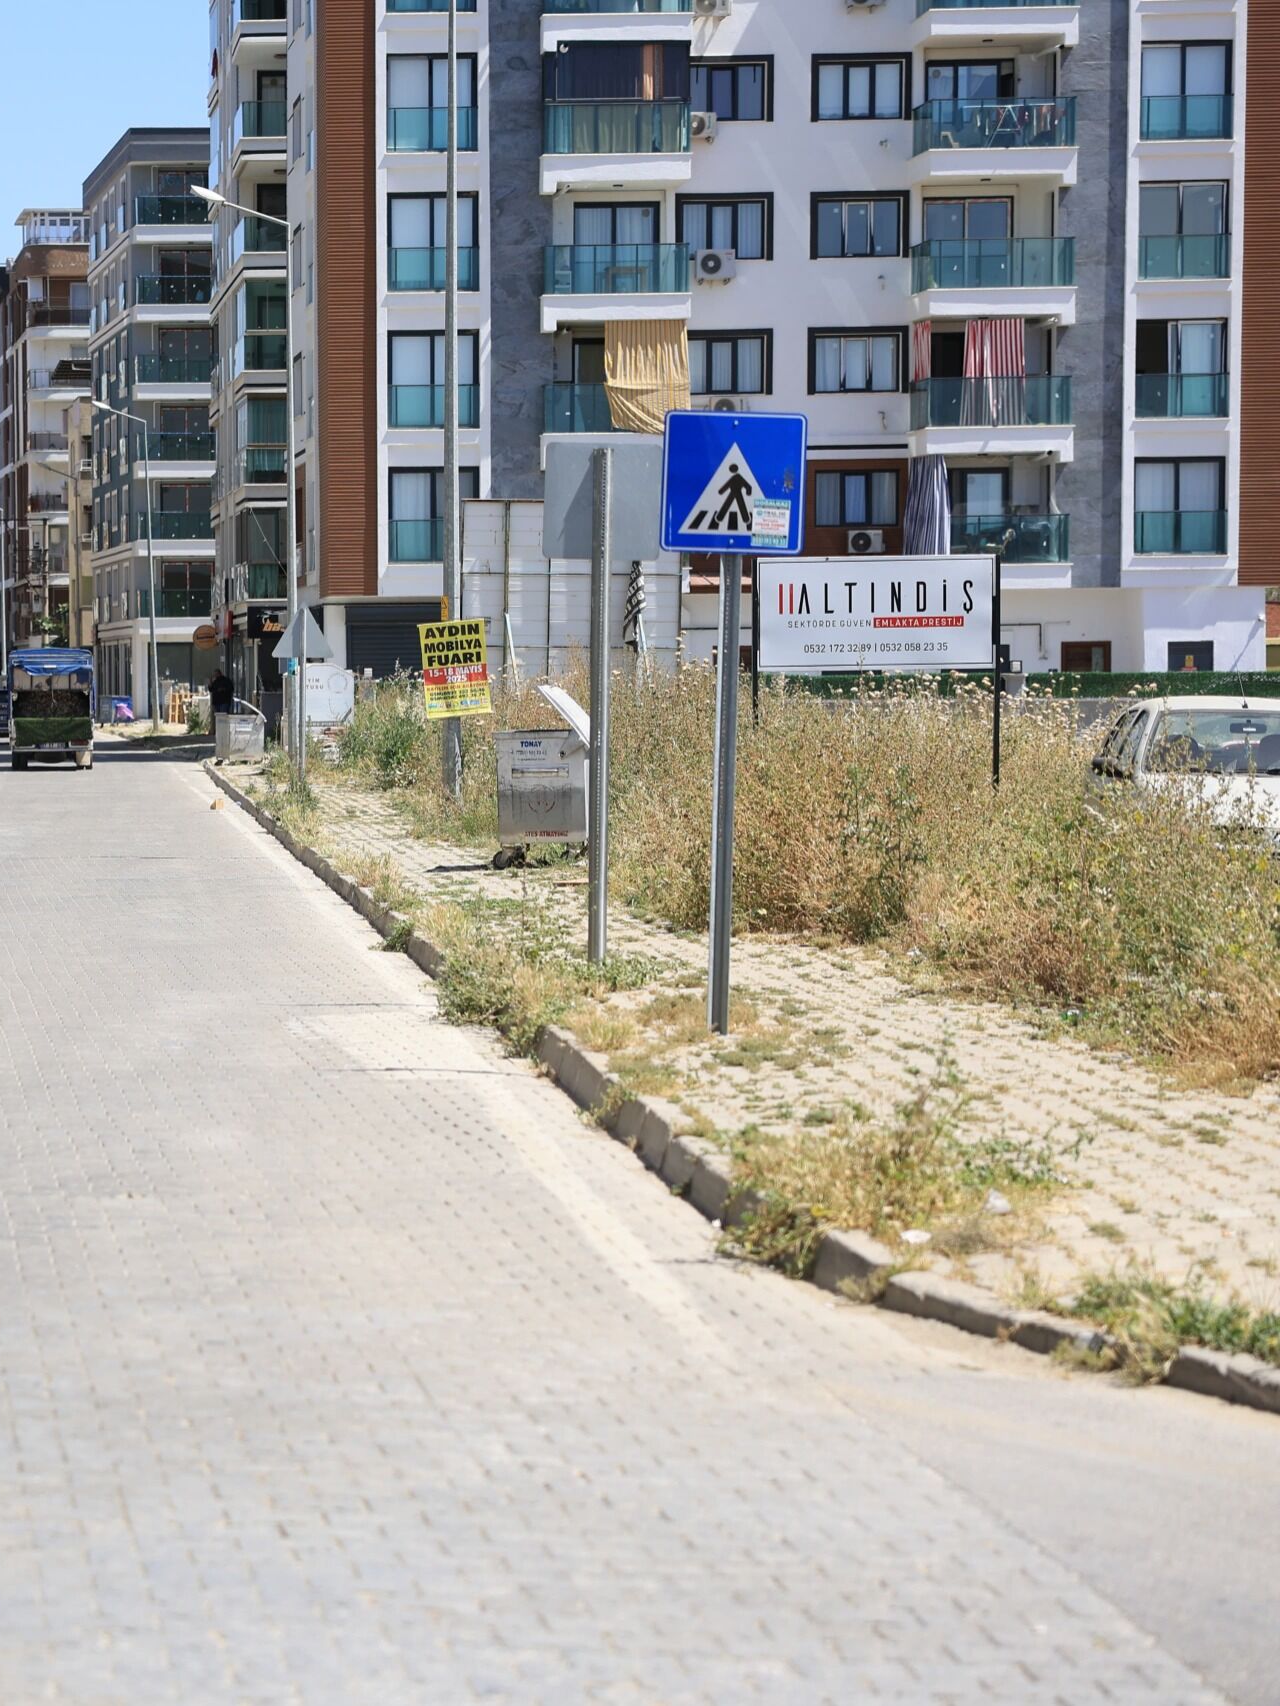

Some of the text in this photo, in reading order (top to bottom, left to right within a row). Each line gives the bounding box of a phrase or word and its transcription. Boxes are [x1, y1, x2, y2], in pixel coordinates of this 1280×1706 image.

[839, 619, 872, 628] GÜVEN
[424, 623, 480, 640] AYDIN
[424, 637, 483, 654] MOBİLYA
[803, 642, 948, 654] 0532 172 32 89 0532 058 23 35
[427, 651, 482, 668] FUARI
[429, 664, 483, 678] 15-18 MAYIS
[446, 674, 468, 683] 2025
